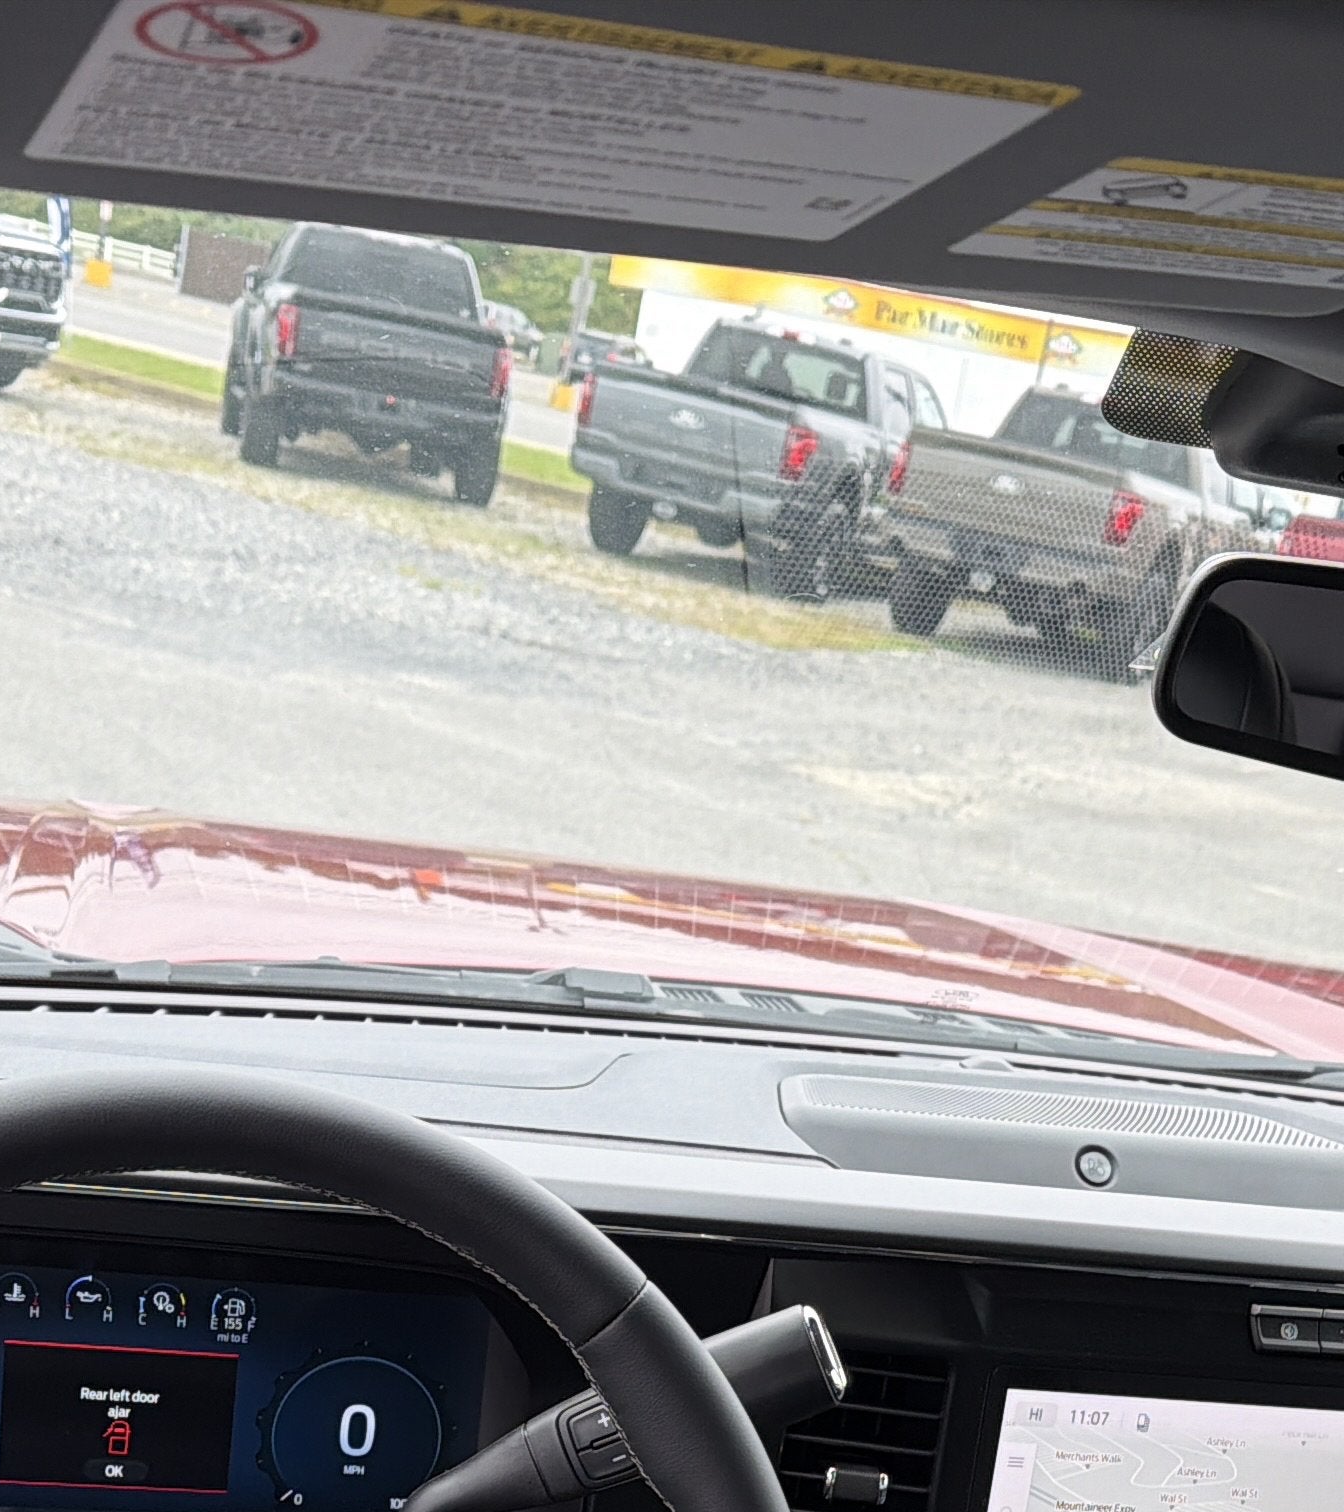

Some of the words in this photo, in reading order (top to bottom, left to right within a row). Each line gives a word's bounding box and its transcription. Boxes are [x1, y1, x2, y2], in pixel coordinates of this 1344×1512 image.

[963, 318, 1029, 349] Stores
[224, 1318, 243, 1330] 155
[230, 1332, 241, 1343] to
[241, 1333, 249, 1344] E
[80, 1386, 108, 1401] Rear
[109, 1388, 131, 1402] left
[131, 1390, 160, 1404] door
[107, 1405, 131, 1419] ajar
[1029, 1408, 1043, 1422] HI
[1070, 1409, 1110, 1426] 11:07
[339, 1404, 377, 1457] 0
[1206, 1437, 1233, 1449] Ashley
[1235, 1439, 1246, 1448] Ln
[1055, 1451, 1100, 1463] Merchants
[1101, 1453, 1122, 1463] Walk
[104, 1465, 124, 1478] OK
[343, 1464, 365, 1475] MPH
[1177, 1467, 1203, 1479] Ashley
[1205, 1469, 1216, 1478] Ln
[1160, 1493, 1175, 1503] Wal
[1176, 1493, 1187, 1504] St
[1231, 1488, 1246, 1498] Wal
[1246, 1488, 1258, 1498] St
[1055, 1500, 1113, 1512] Mountaineer
